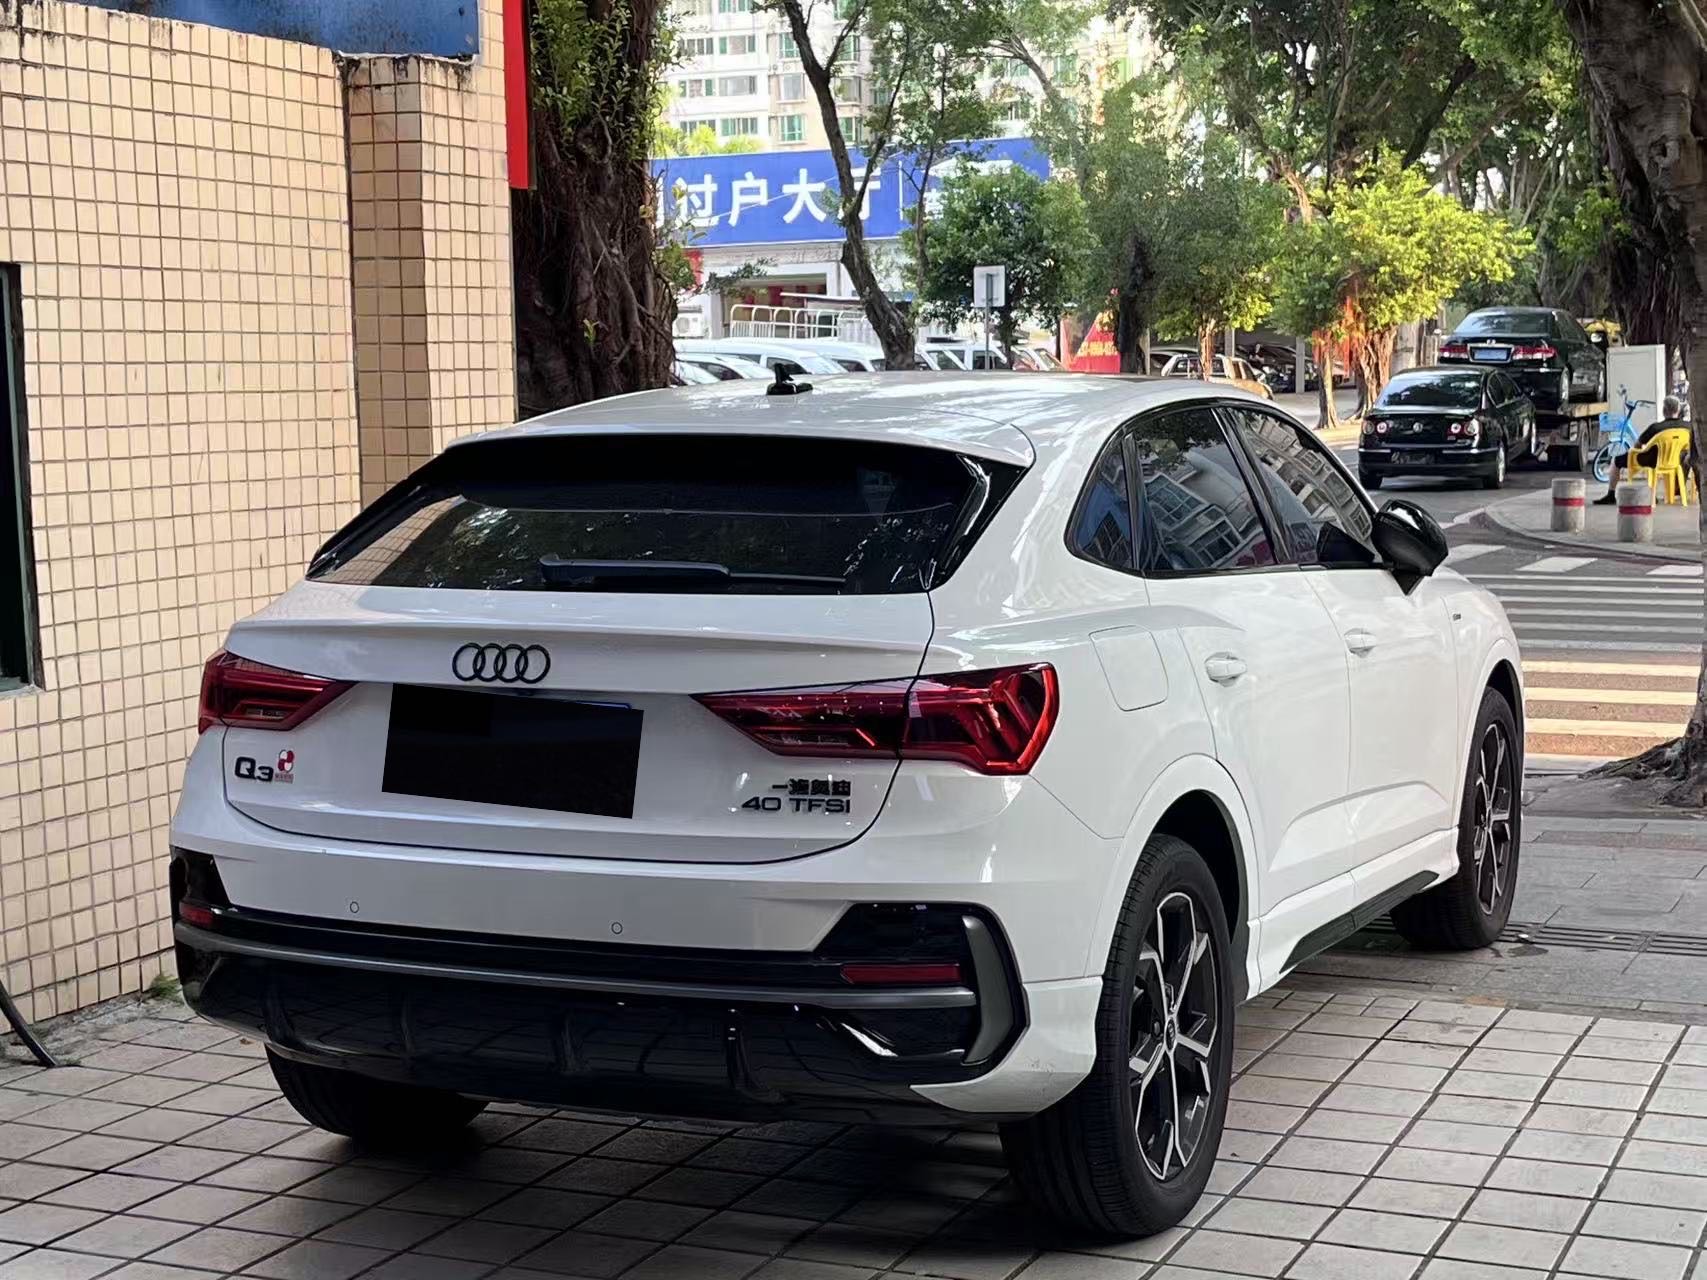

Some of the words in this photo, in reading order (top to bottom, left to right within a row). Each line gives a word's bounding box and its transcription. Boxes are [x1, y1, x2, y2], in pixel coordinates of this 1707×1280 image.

[656, 168, 881, 229] 过户大厅
[235, 757, 274, 782] Q3
[742, 797, 781, 811] 40
[789, 798, 850, 813] TFSI
